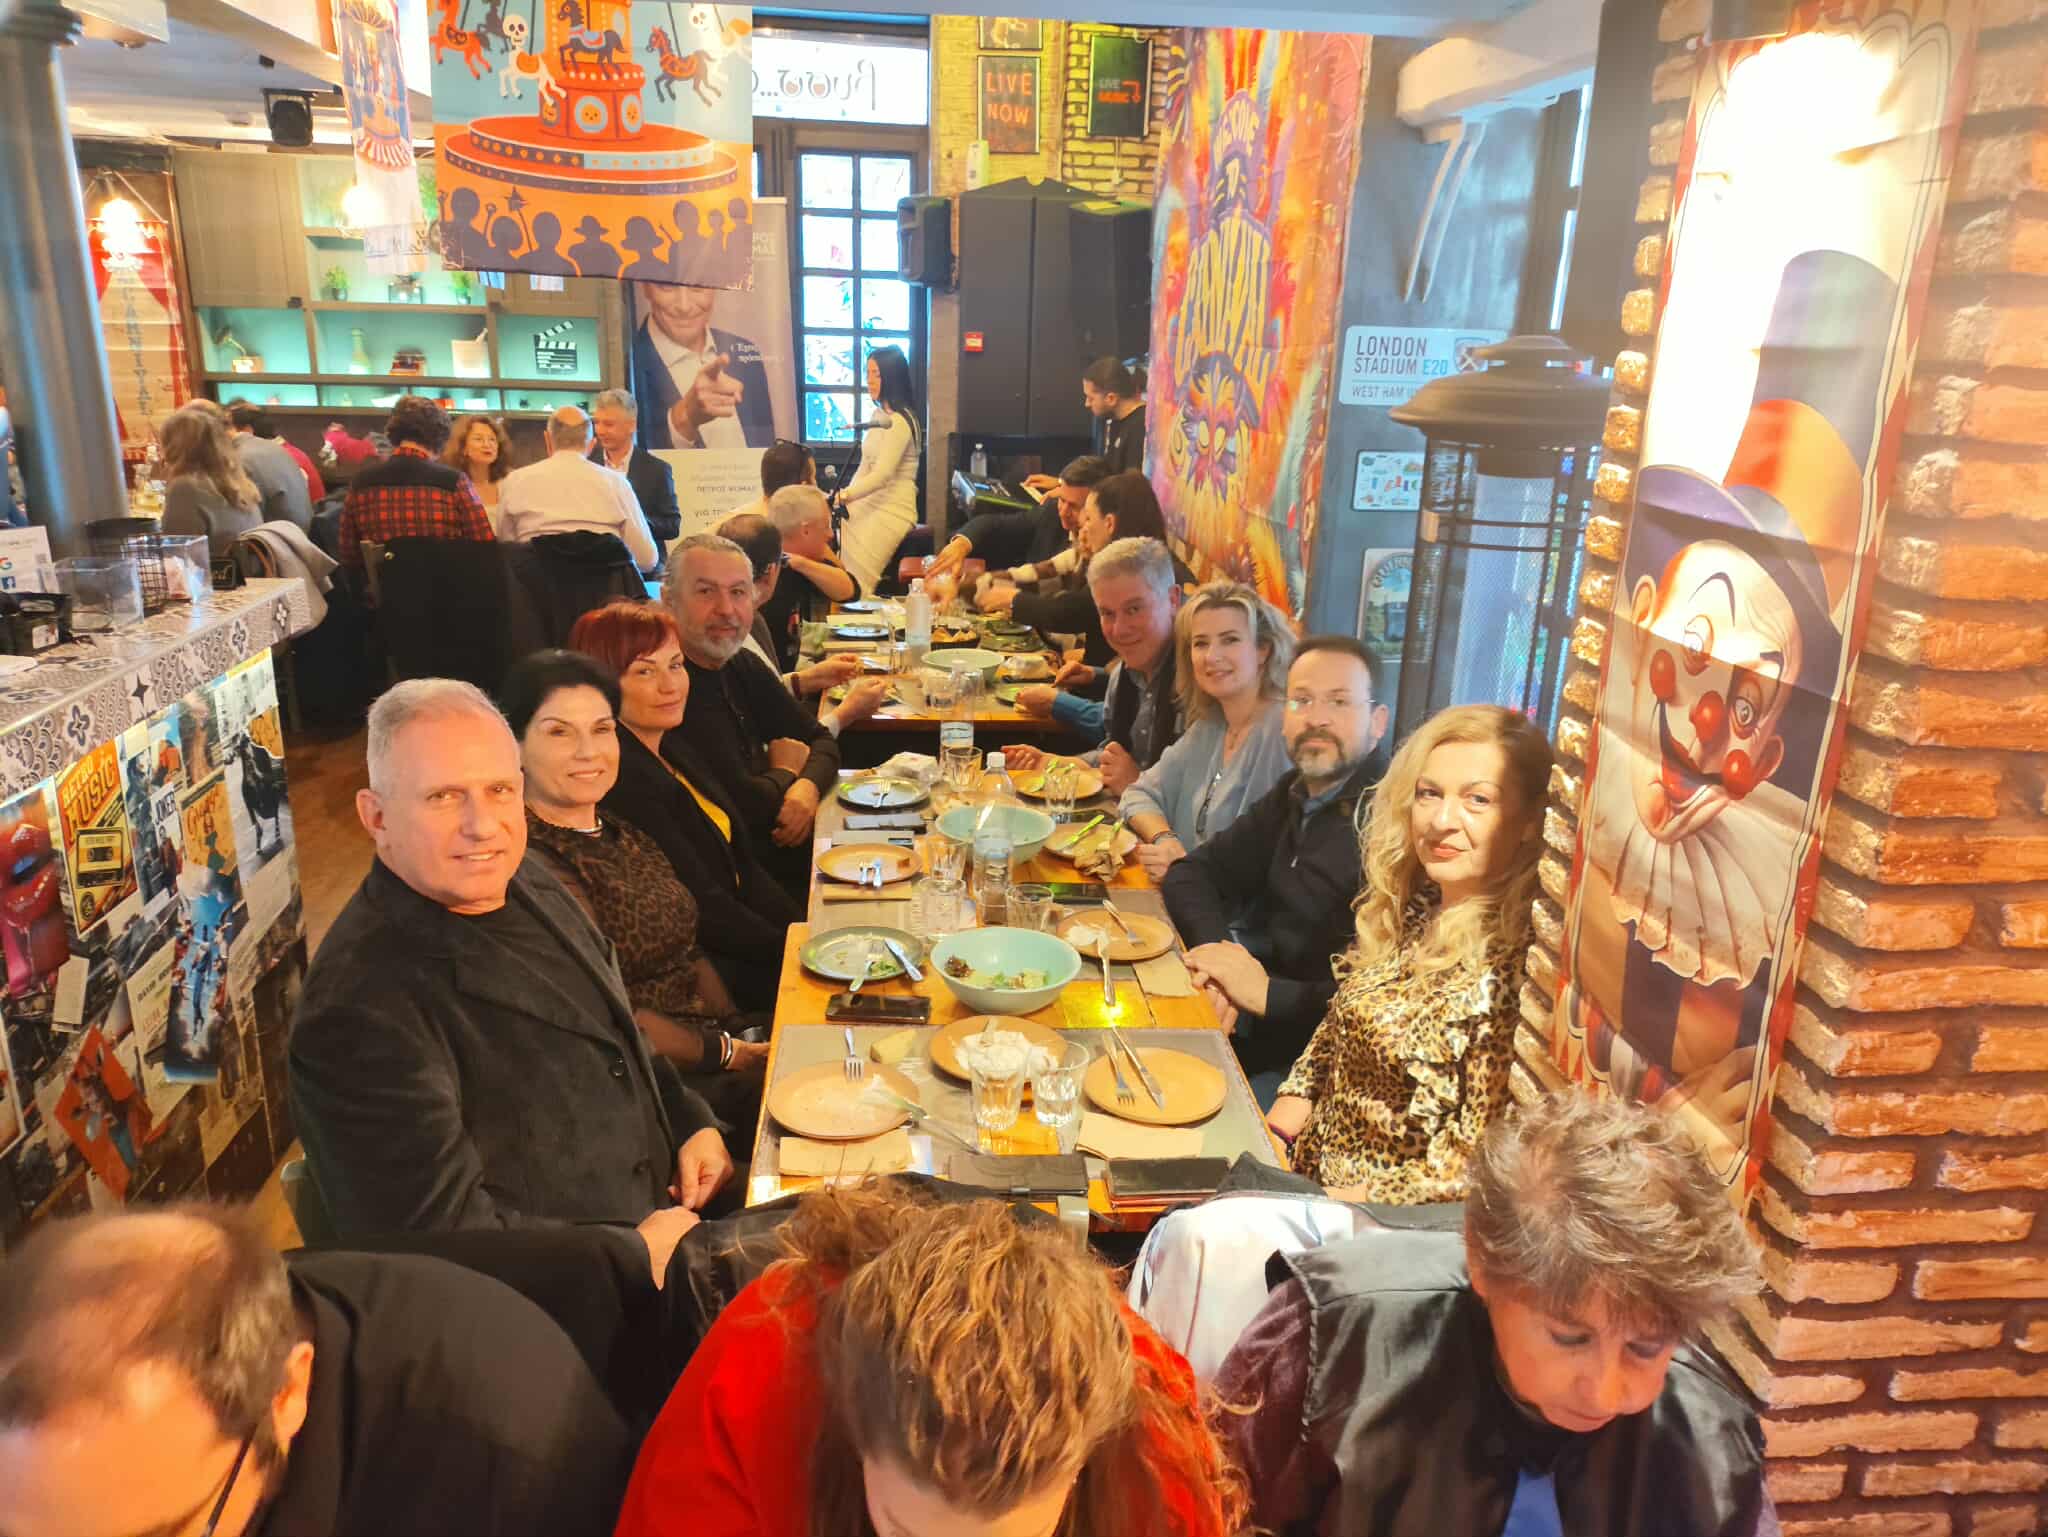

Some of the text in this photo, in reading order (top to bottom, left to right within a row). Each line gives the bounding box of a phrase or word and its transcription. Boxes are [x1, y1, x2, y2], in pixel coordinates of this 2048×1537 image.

[986, 71, 1032, 97] LIVE
[987, 103, 1030, 126] NOW
[1356, 335, 1428, 357] LONDON
[1354, 357, 1449, 376] STADIUM E20
[1352, 383, 1380, 399] WEST
[1382, 384, 1405, 399] HAM
[61, 754, 95, 808] RETRO
[65, 756, 116, 844] MUSIC
